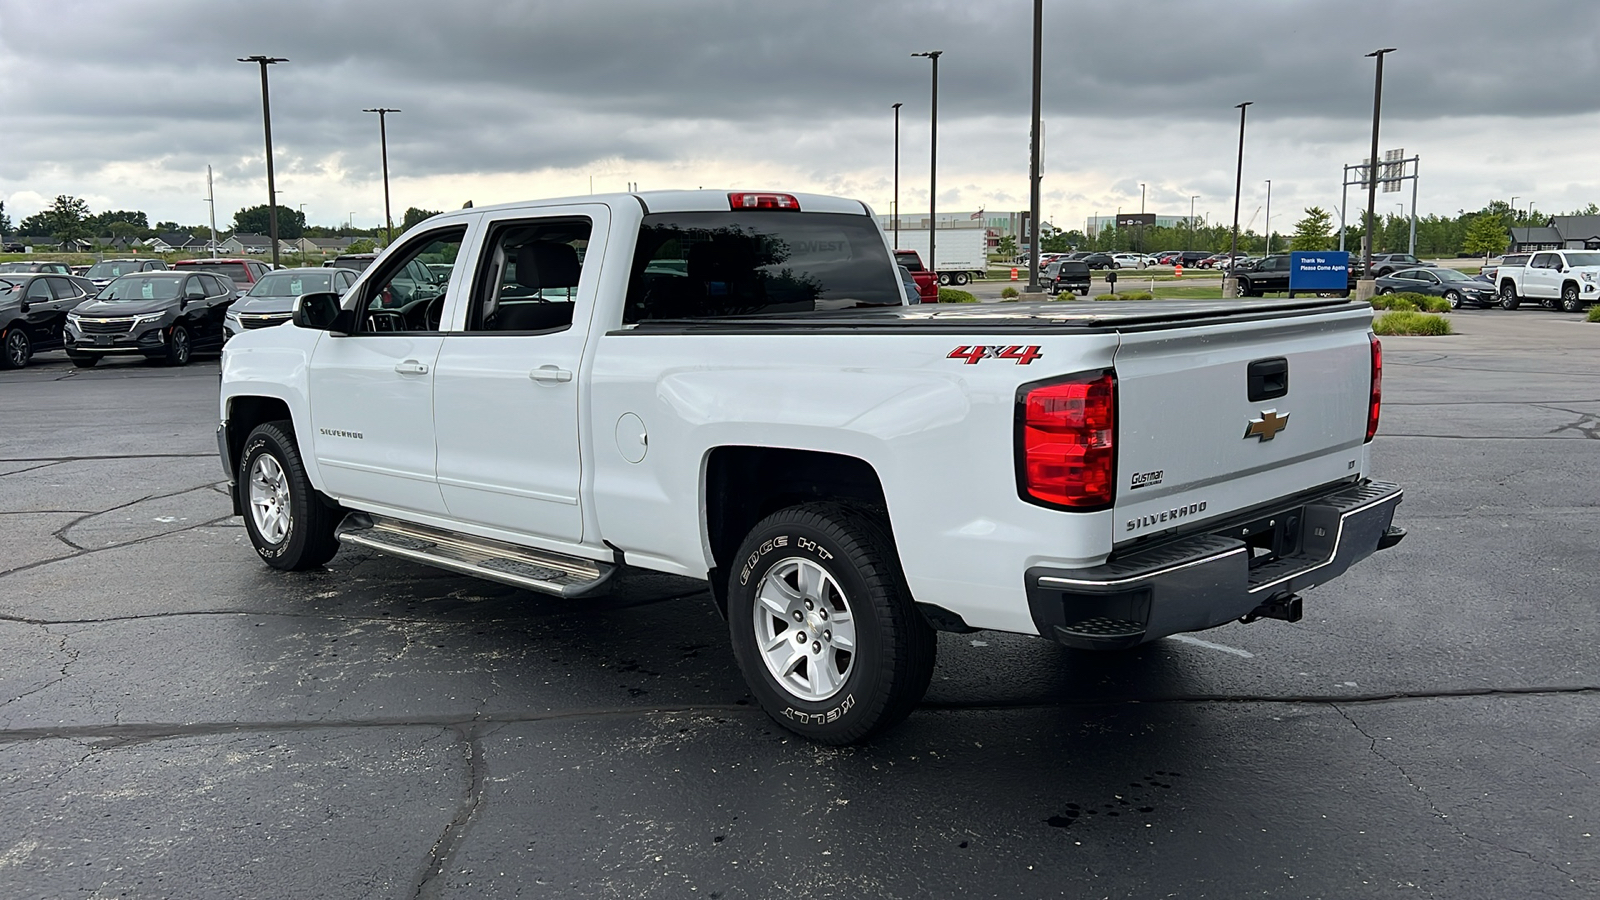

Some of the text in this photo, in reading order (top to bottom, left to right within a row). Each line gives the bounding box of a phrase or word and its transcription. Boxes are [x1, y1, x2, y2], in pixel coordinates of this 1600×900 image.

[319, 427, 364, 441] SILVERADO
[1126, 500, 1207, 532] SILVERADO
[739, 535, 834, 586] EDGE HT
[779, 693, 856, 725] KELLY
